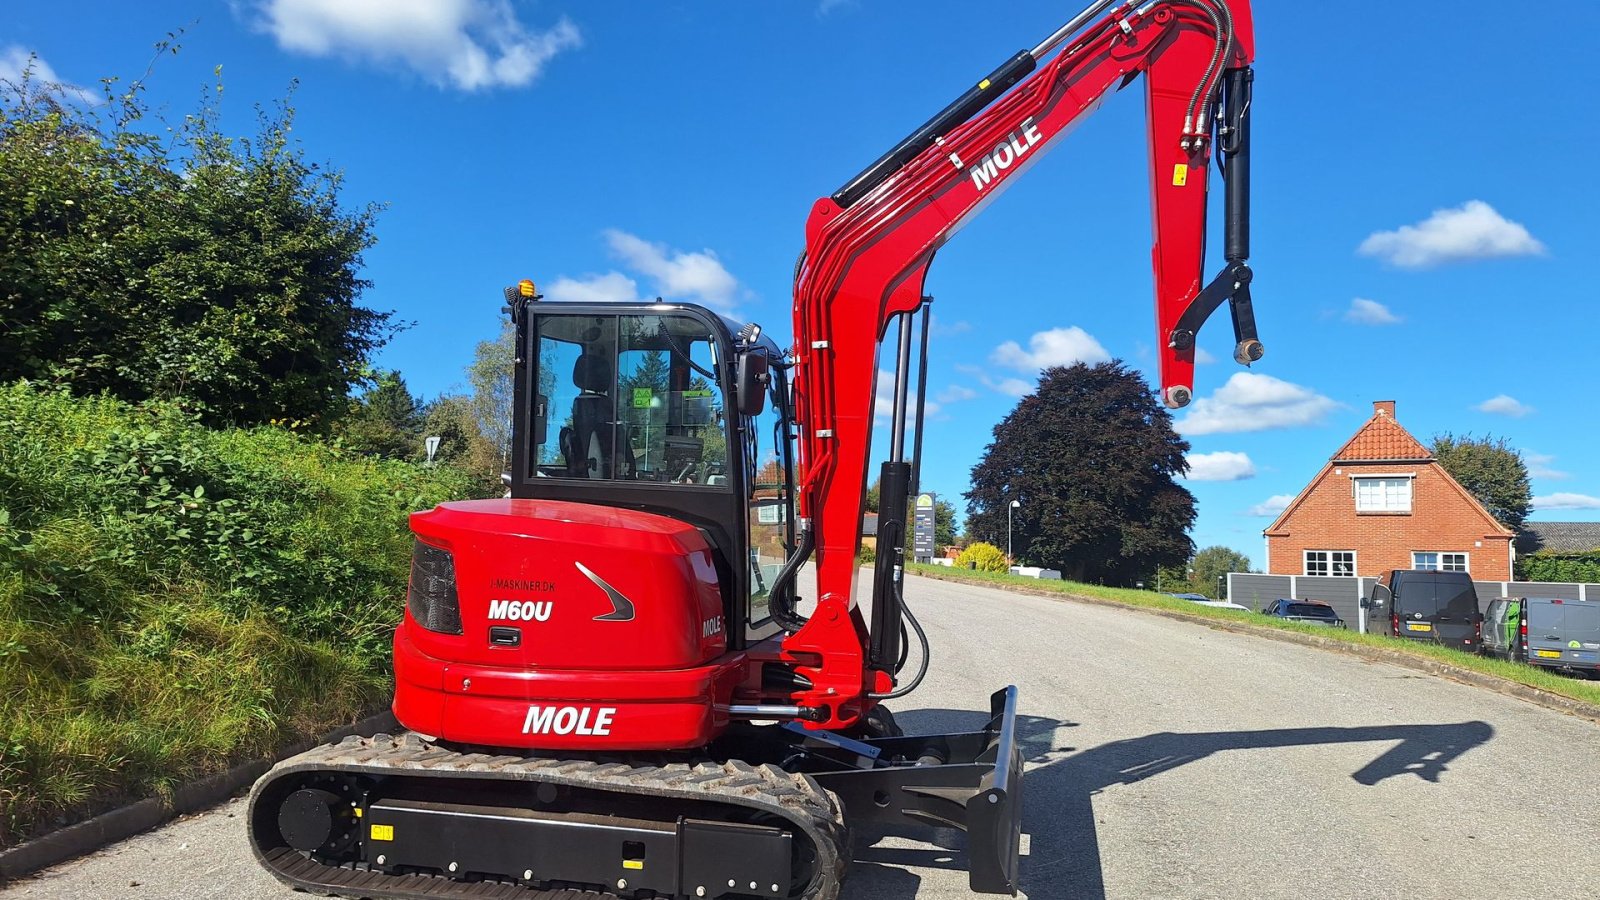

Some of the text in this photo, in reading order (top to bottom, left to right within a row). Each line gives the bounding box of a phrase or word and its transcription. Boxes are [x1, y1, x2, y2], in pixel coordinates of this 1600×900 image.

[969, 116, 1043, 191] MOLE
[488, 600, 553, 622] M60U
[703, 615, 721, 638] MOLE
[522, 706, 617, 736] MOLE
